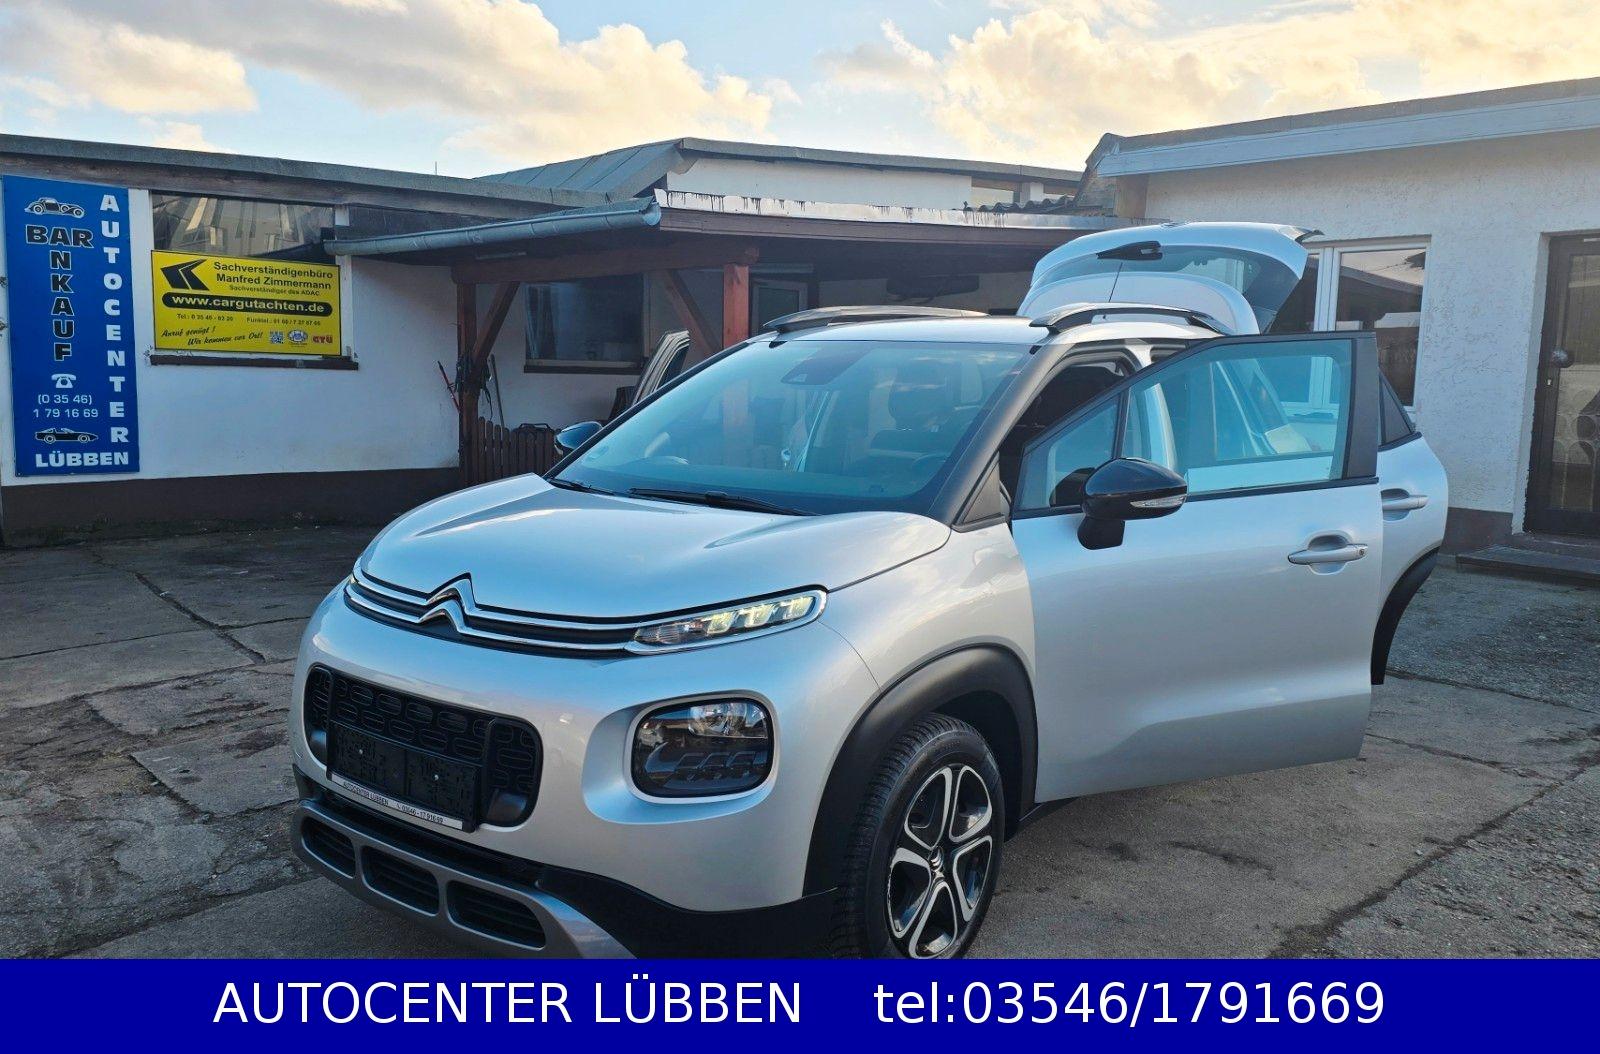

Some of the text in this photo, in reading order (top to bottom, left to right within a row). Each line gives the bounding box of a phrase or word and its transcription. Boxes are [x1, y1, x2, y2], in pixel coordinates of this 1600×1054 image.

[25, 224, 94, 248] BAR
[213, 261, 333, 279] Sachverständigenbüro
[216, 273, 331, 290] Manfred Zimmermann
[171, 295, 325, 313] www.cargutachten.de
[100, 194, 129, 443] AUTOCENTER
[187, 336, 201, 346] Wir
[203, 336, 232, 345] kommen
[37, 394, 93, 405] (0 35 46)
[33, 408, 99, 418] 1 79 16 69
[35, 450, 129, 468] LÜBBEN
